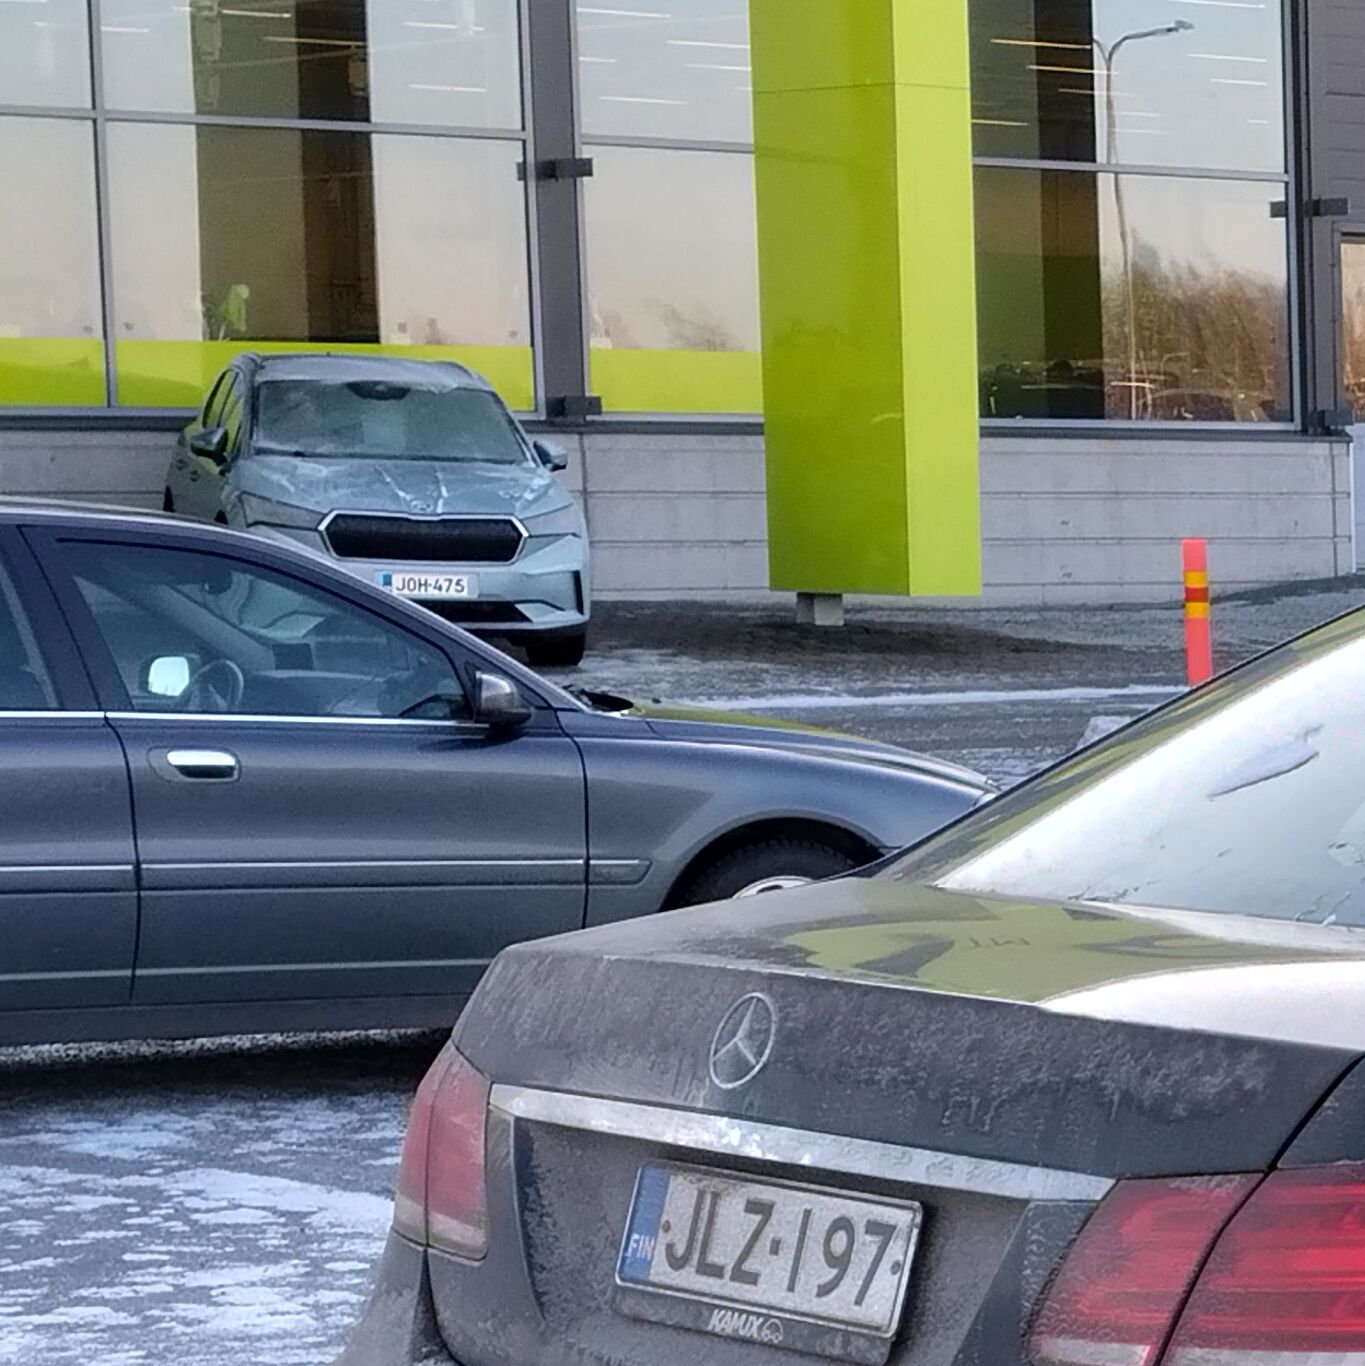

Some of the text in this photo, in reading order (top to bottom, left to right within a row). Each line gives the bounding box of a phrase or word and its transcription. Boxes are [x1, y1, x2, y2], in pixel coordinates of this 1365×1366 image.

[396, 577, 465, 593] JOH-475
[626, 1187, 898, 1307] FIN JLZ-197
[707, 1308, 763, 1339] KAMUX
